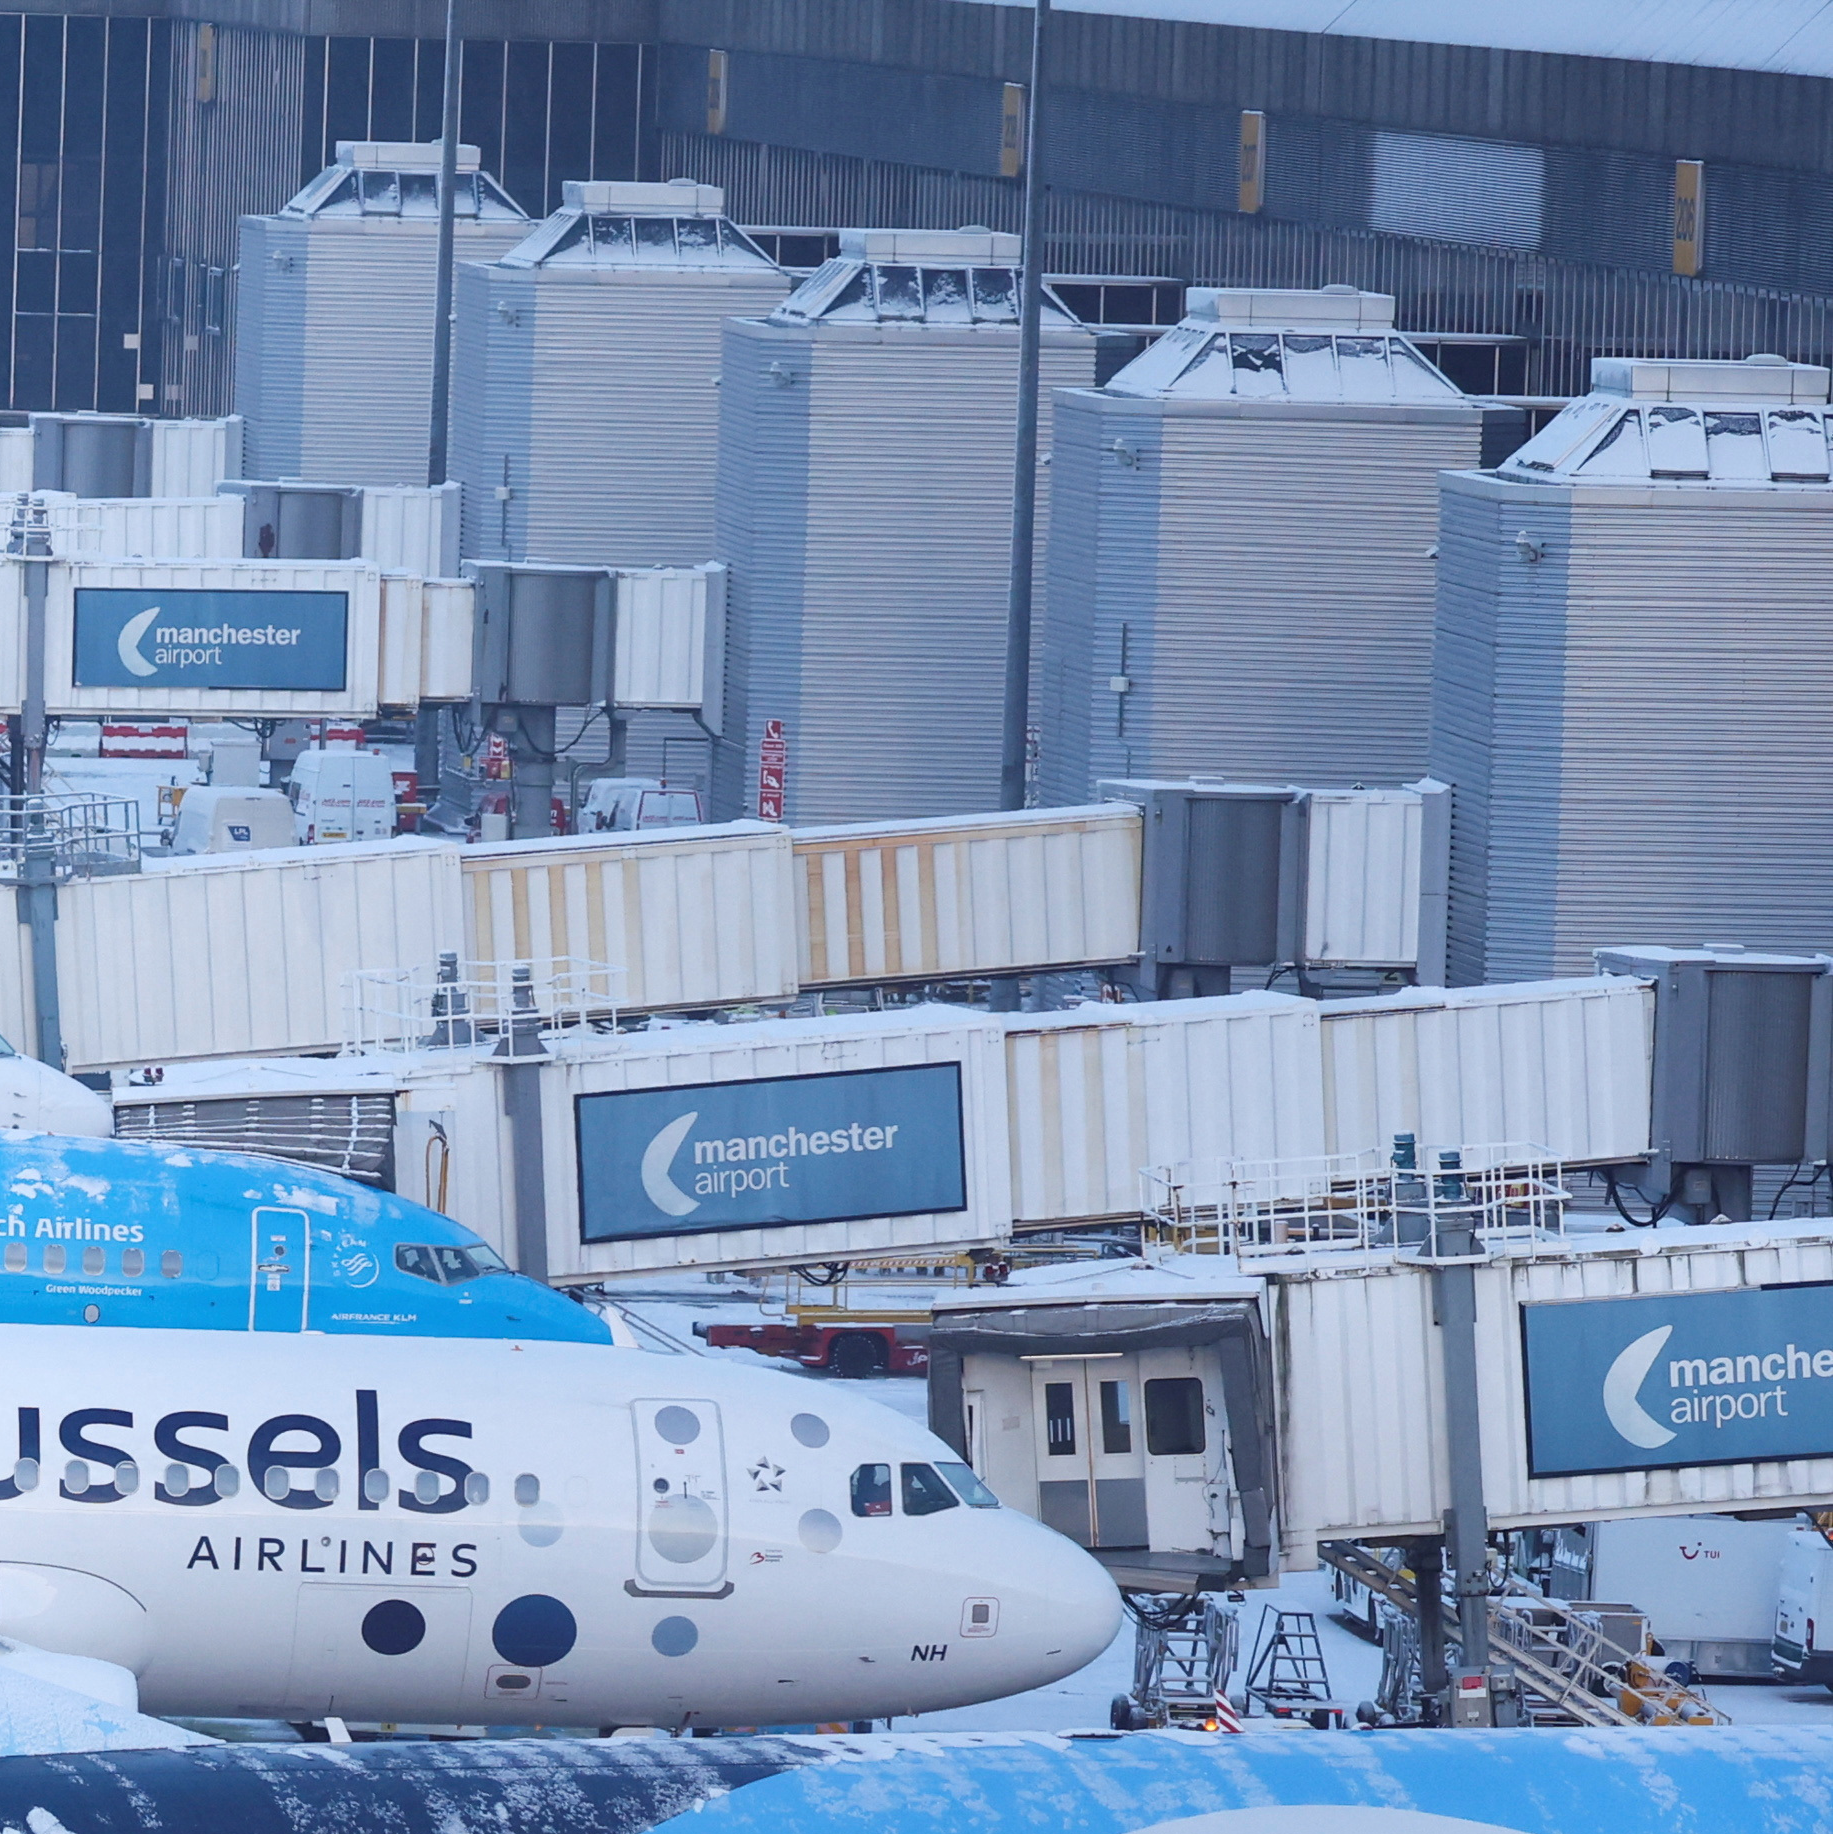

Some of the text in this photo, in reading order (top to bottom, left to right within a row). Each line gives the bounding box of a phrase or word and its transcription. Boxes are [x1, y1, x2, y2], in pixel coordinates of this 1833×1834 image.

[155, 623, 301, 646] manchester
[155, 644, 222, 669] airport
[694, 1122, 899, 1165] manchester
[695, 1161, 790, 1199] airport
[35, 1216, 145, 1244] Airlines
[45, 1283, 143, 1299] Green Woodpecker
[393, 1313, 418, 1322] KLM
[1670, 1385, 1789, 1429] airport
[186, 1535, 479, 1577] AIRLINES
[1704, 1550, 1720, 1559] TUI
[910, 1644, 948, 1662] NH
